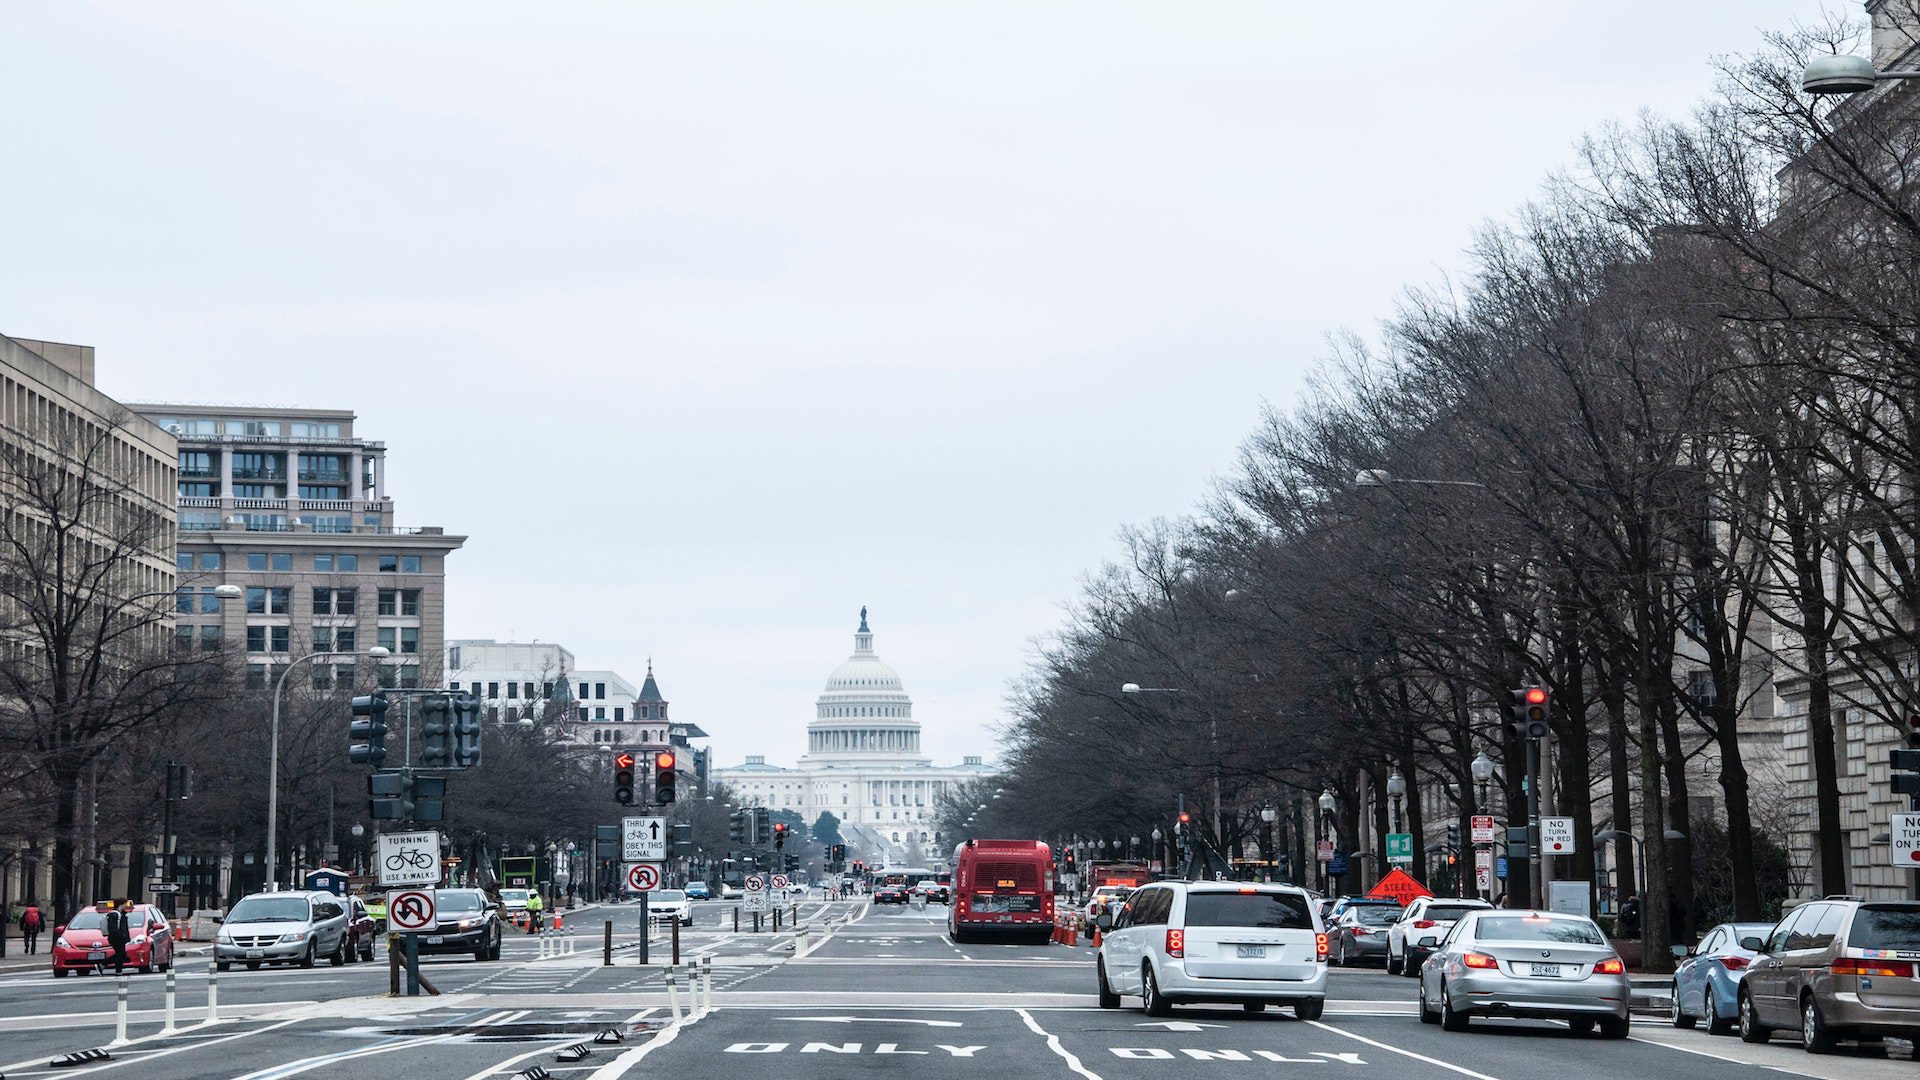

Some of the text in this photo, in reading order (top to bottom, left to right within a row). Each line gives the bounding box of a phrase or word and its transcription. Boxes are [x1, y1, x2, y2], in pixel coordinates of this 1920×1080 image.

[1905, 817, 1920, 827] N
[389, 836, 429, 844] TURNING
[1896, 840, 1910, 848] ON
[402, 872, 435, 880] X-WALKS
[1384, 884, 1412, 892] STEEL
[722, 1042, 989, 1058] ONLY
[1108, 1048, 1370, 1065] ONLY
